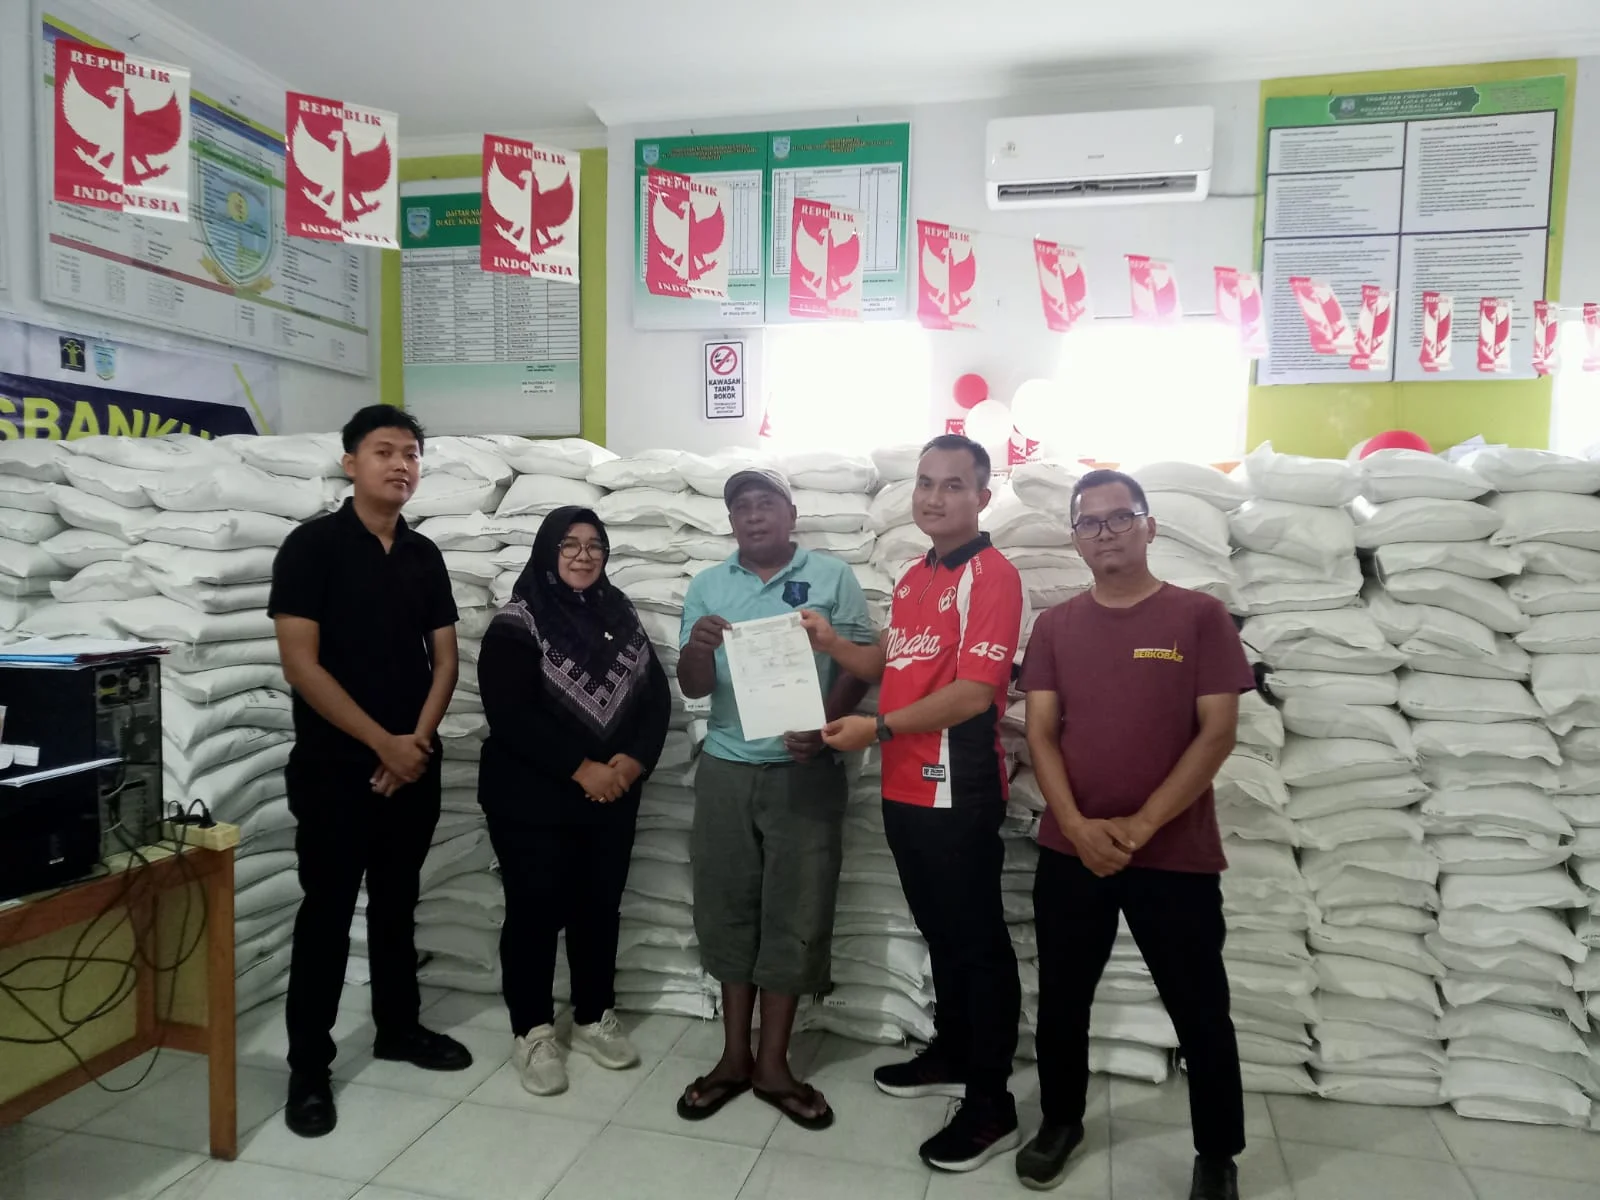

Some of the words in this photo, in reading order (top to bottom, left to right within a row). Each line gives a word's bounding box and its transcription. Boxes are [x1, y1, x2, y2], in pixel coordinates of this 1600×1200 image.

[70, 49, 171, 83] REPUBLIK
[298, 99, 382, 127] REPUBLIK
[494, 141, 567, 166] REPUBLIK
[657, 174, 719, 197] REPUBLIK
[73, 184, 181, 214] INDONESIA
[800, 203, 855, 224] REPUBLIK
[300, 222, 392, 244] INDONESIA
[924, 226, 971, 243] REPUBLIK
[493, 255, 574, 277] INDONESIA
[658, 280, 725, 298] INDONESIA
[708, 378, 741, 386] KAWASAN
[969, 641, 1008, 661] 45
